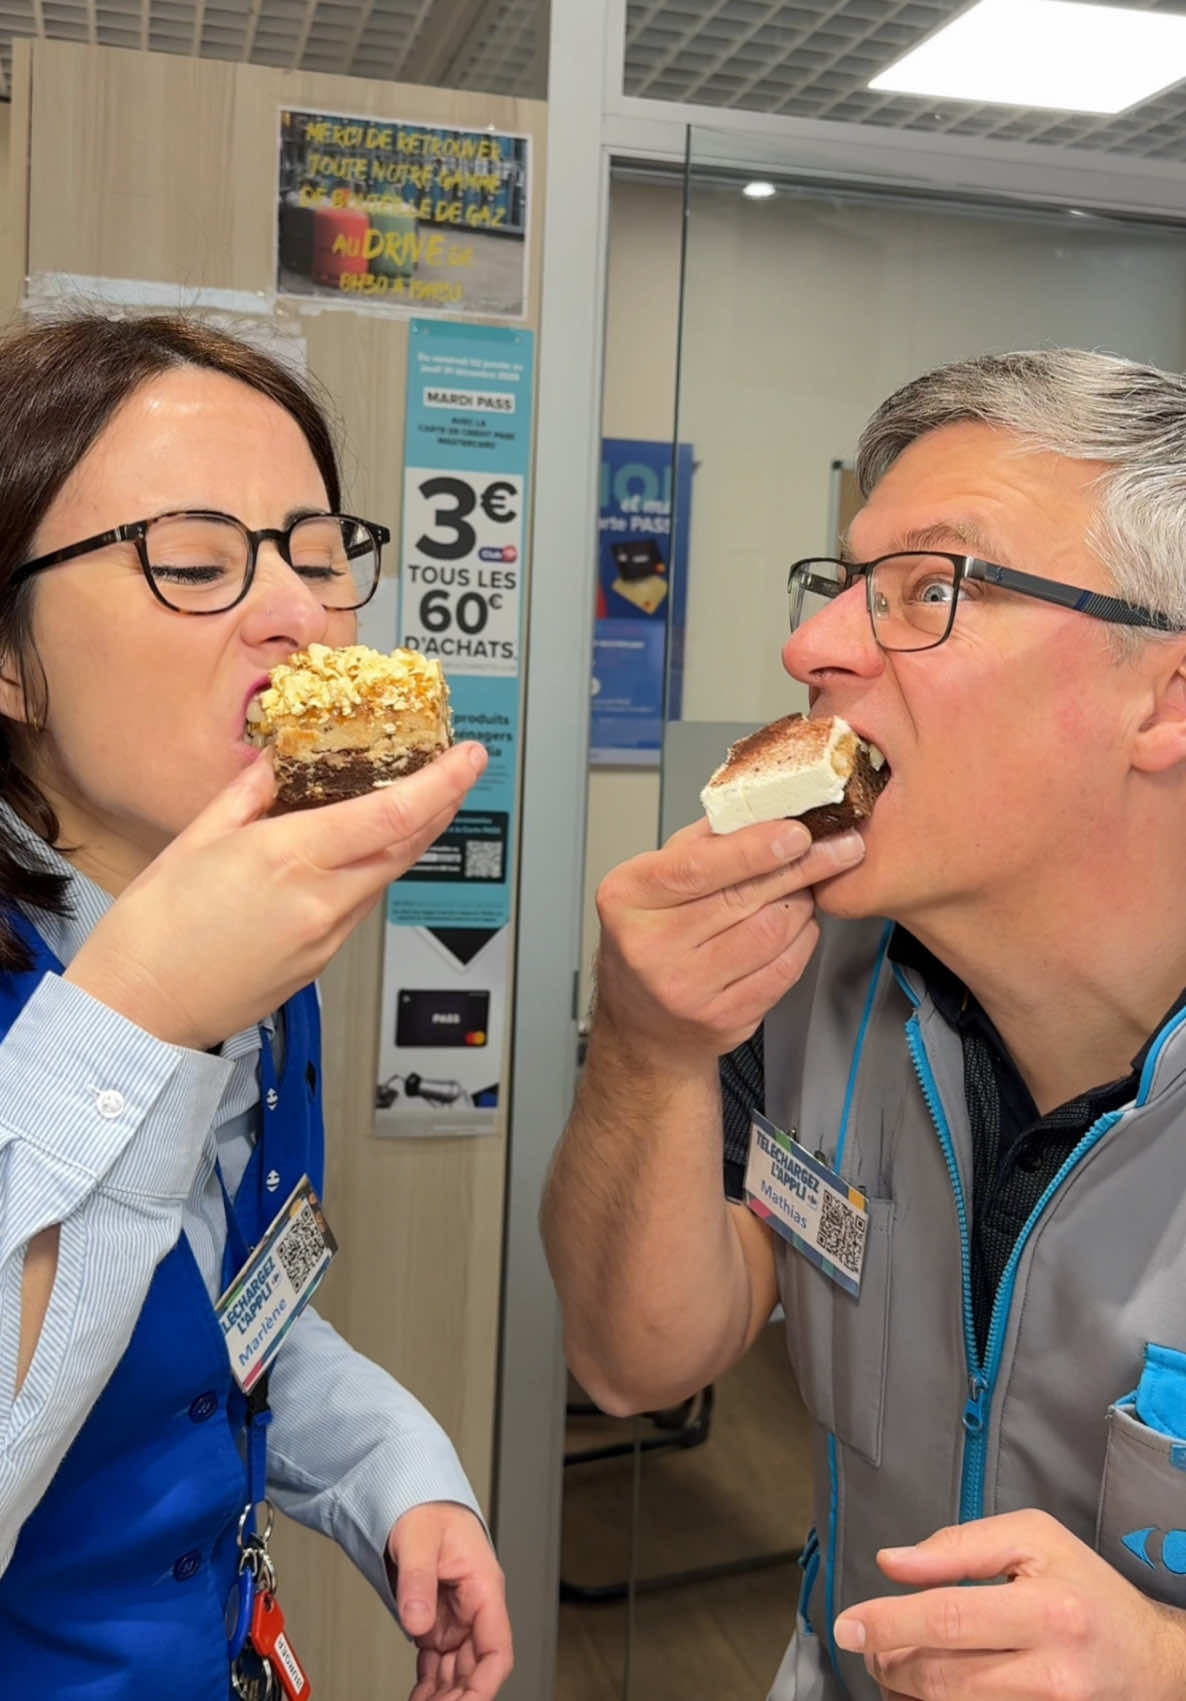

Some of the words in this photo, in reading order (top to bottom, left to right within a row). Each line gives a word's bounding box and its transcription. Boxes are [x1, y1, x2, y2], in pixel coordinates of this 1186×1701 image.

[305, 121, 362, 148] MERCI
[365, 126, 394, 150] DE
[397, 131, 501, 163] RETROUVER
[307, 153, 368, 181] TOUTE
[371, 159, 433, 189] NOTRE
[436, 201, 462, 223] DE
[465, 204, 507, 230] GAZ
[332, 233, 361, 257] AU
[361, 228, 446, 266] DRIVE
[427, 391, 473, 406] MARDI
[477, 397, 513, 410] PASS
[408, 564, 470, 587] TOUS
[478, 570, 517, 590] LES
[404, 635, 514, 659] D'ACHATS
[770, 1161, 806, 1200] L'APPLI
[761, 1179, 808, 1229] Mathias
[221, 1255, 276, 1334] LECHARGEZ
[237, 1282, 272, 1335] L'APPLI
[238, 1298, 287, 1367] Marlène
